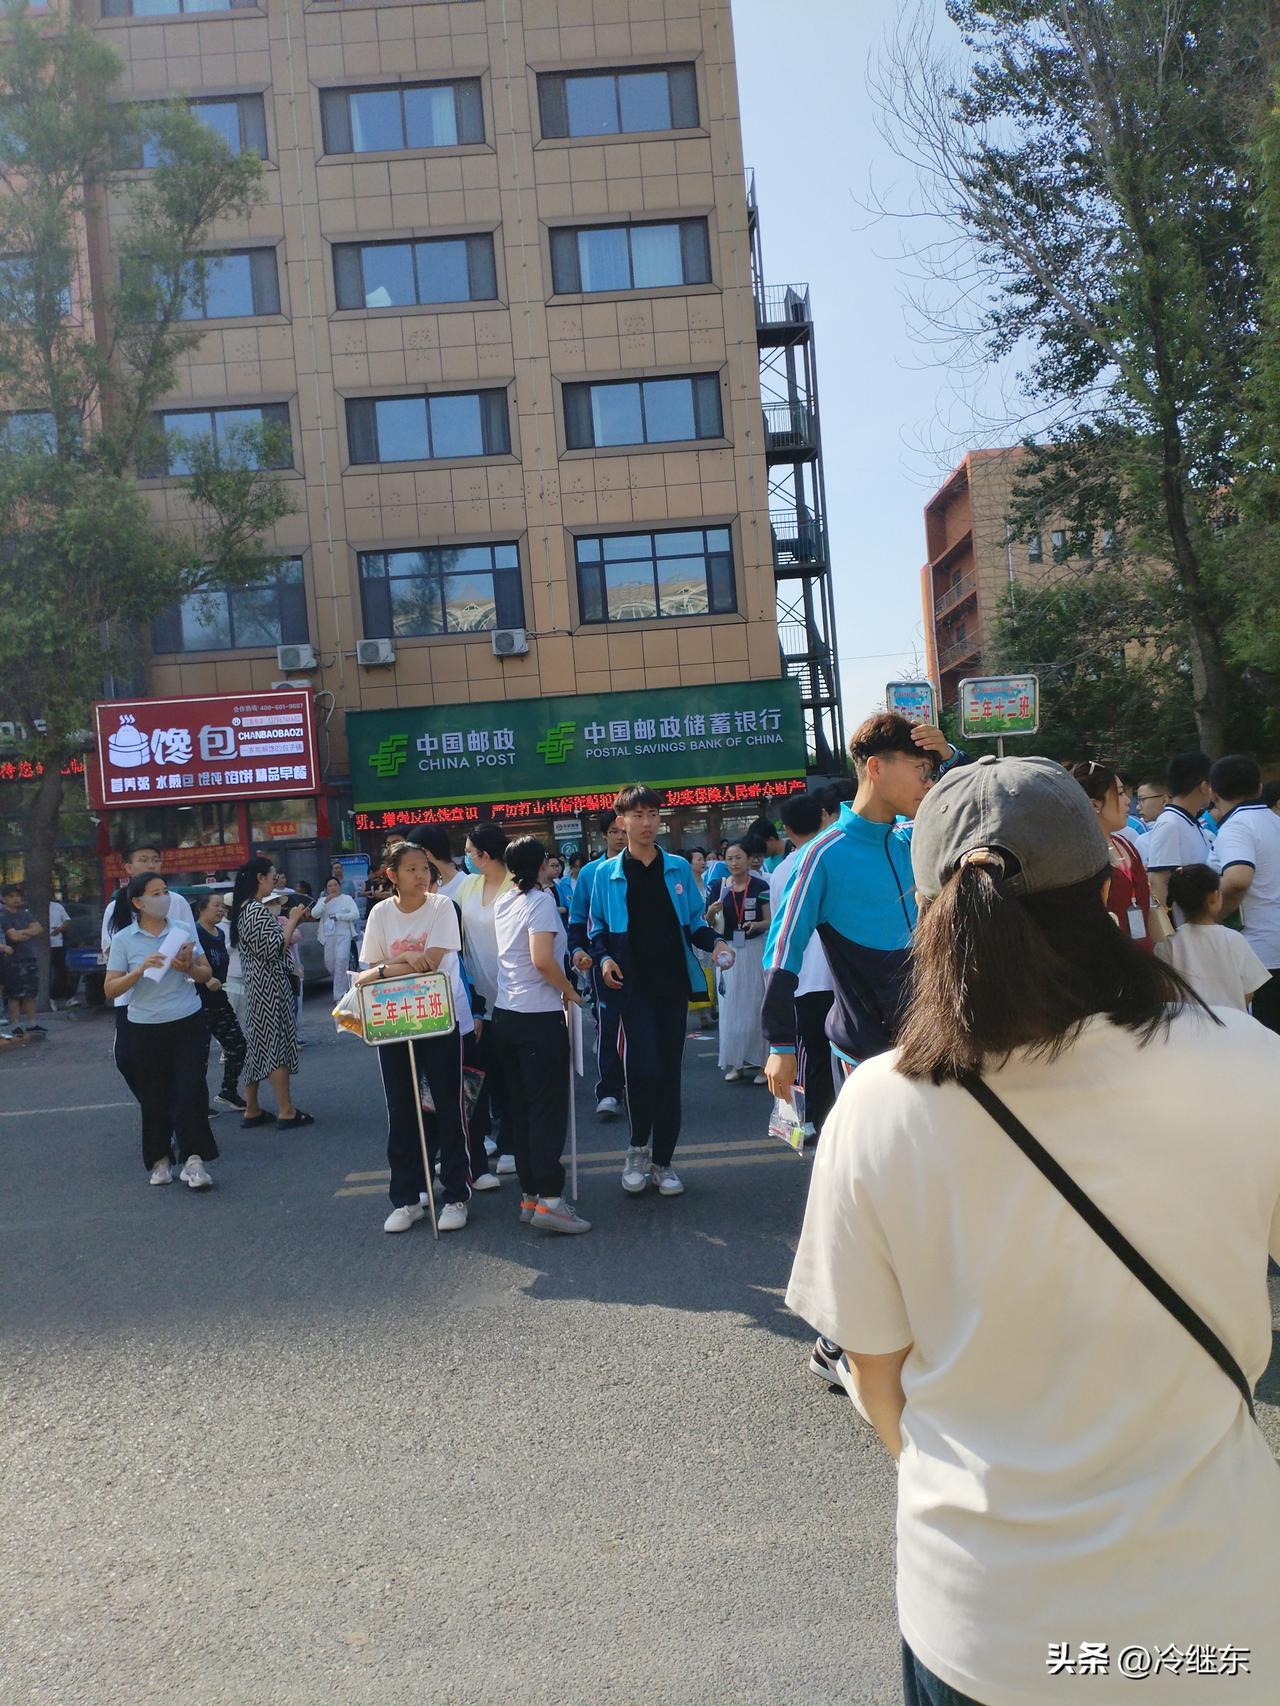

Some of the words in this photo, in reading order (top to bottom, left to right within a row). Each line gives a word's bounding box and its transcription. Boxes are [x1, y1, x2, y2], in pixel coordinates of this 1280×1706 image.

[969, 696, 1029, 721] 三年十二班
[238, 728, 304, 741] CHANBAOBAOZI
[584, 709, 782, 745] 中国邮政储蓄银行
[150, 725, 239, 766] 馋包
[416, 728, 516, 757] 中国邮政
[586, 747, 631, 759] POSTAL
[634, 742, 686, 755] SAVINGS
[690, 739, 722, 751] BANK
[726, 736, 742, 748] OF
[746, 733, 784, 746] CHINA
[418, 757, 470, 772] CHINA
[476, 752, 516, 767] POST
[110, 776, 150, 793] 营养粥
[155, 774, 194, 789] 水煎包
[198, 772, 222, 787] 馄饨
[224, 769, 253, 785] 馅饼
[255, 765, 307, 782] 精品早餐
[371, 993, 443, 1026] 三年十五班
